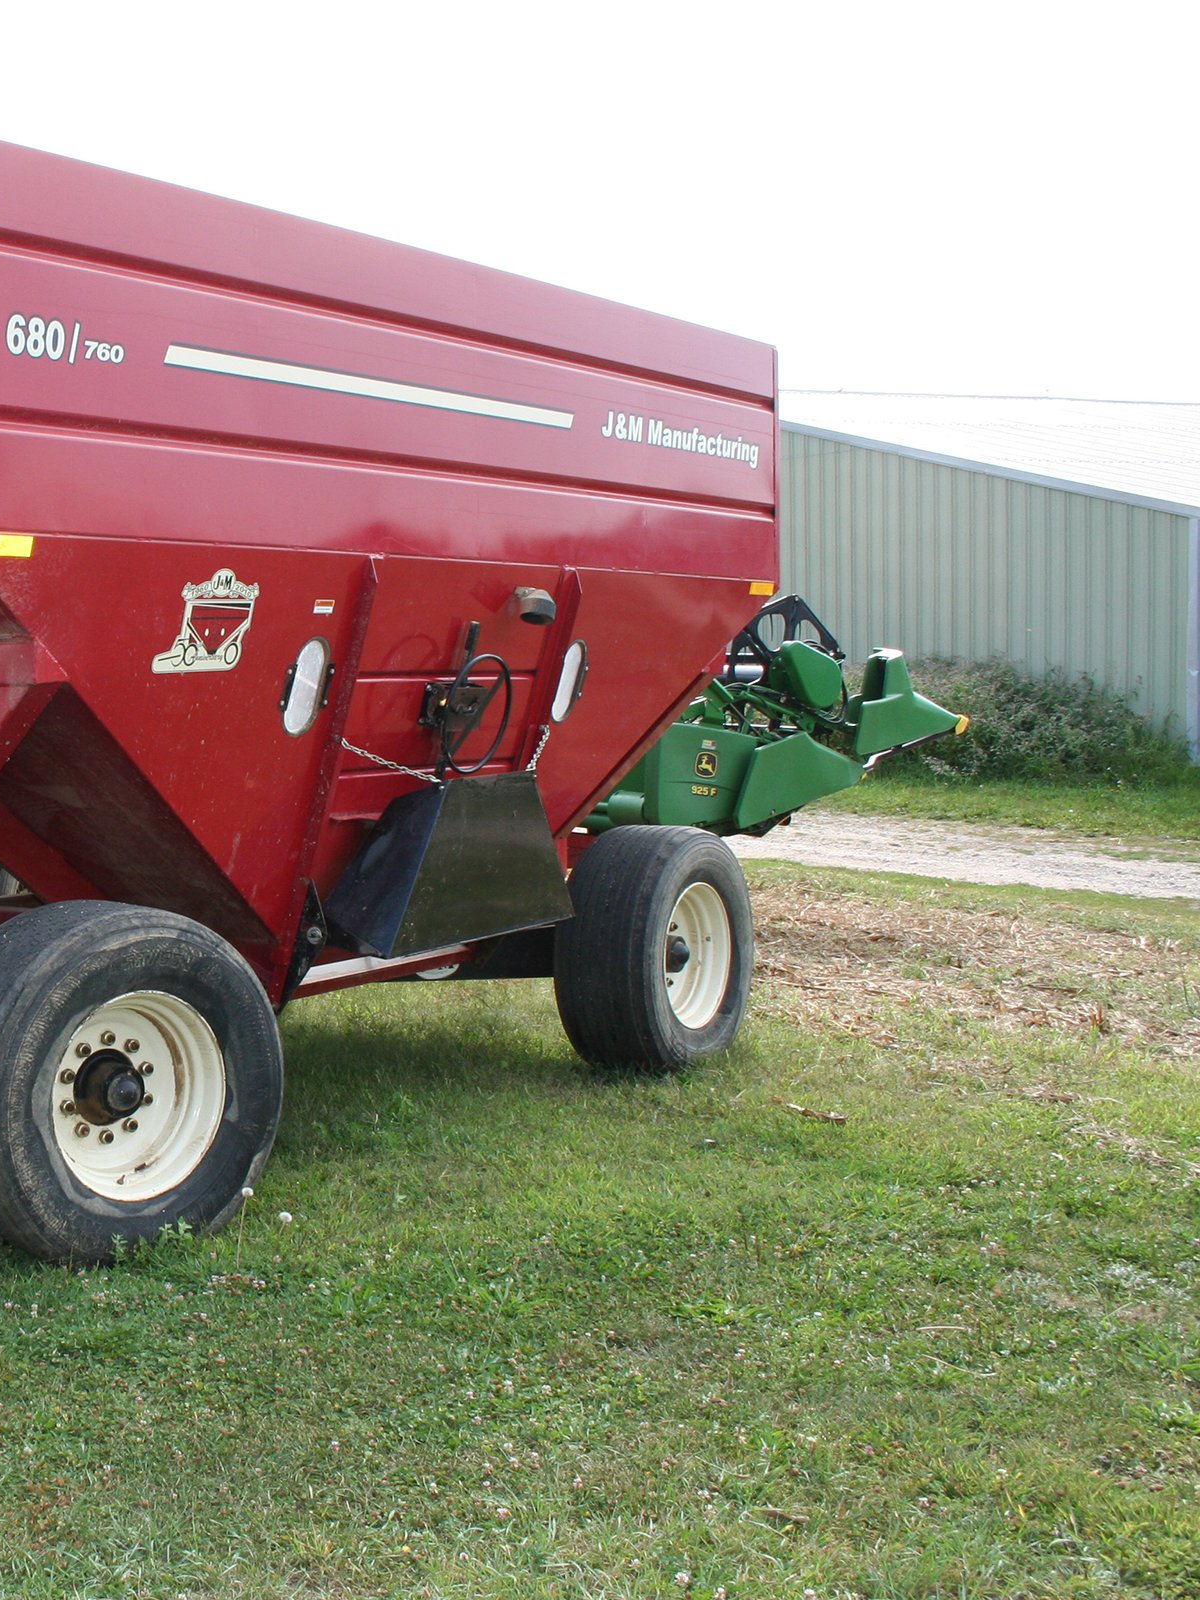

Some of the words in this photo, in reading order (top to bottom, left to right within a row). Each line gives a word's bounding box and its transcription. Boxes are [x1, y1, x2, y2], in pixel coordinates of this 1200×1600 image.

[601, 410, 644, 444] J&M
[647, 418, 760, 470] Manufacturing
[212, 575, 233, 591] J&M
[235, 584, 252, 598] 2010
[691, 785, 709, 796] 925
[710, 787, 718, 797] F
